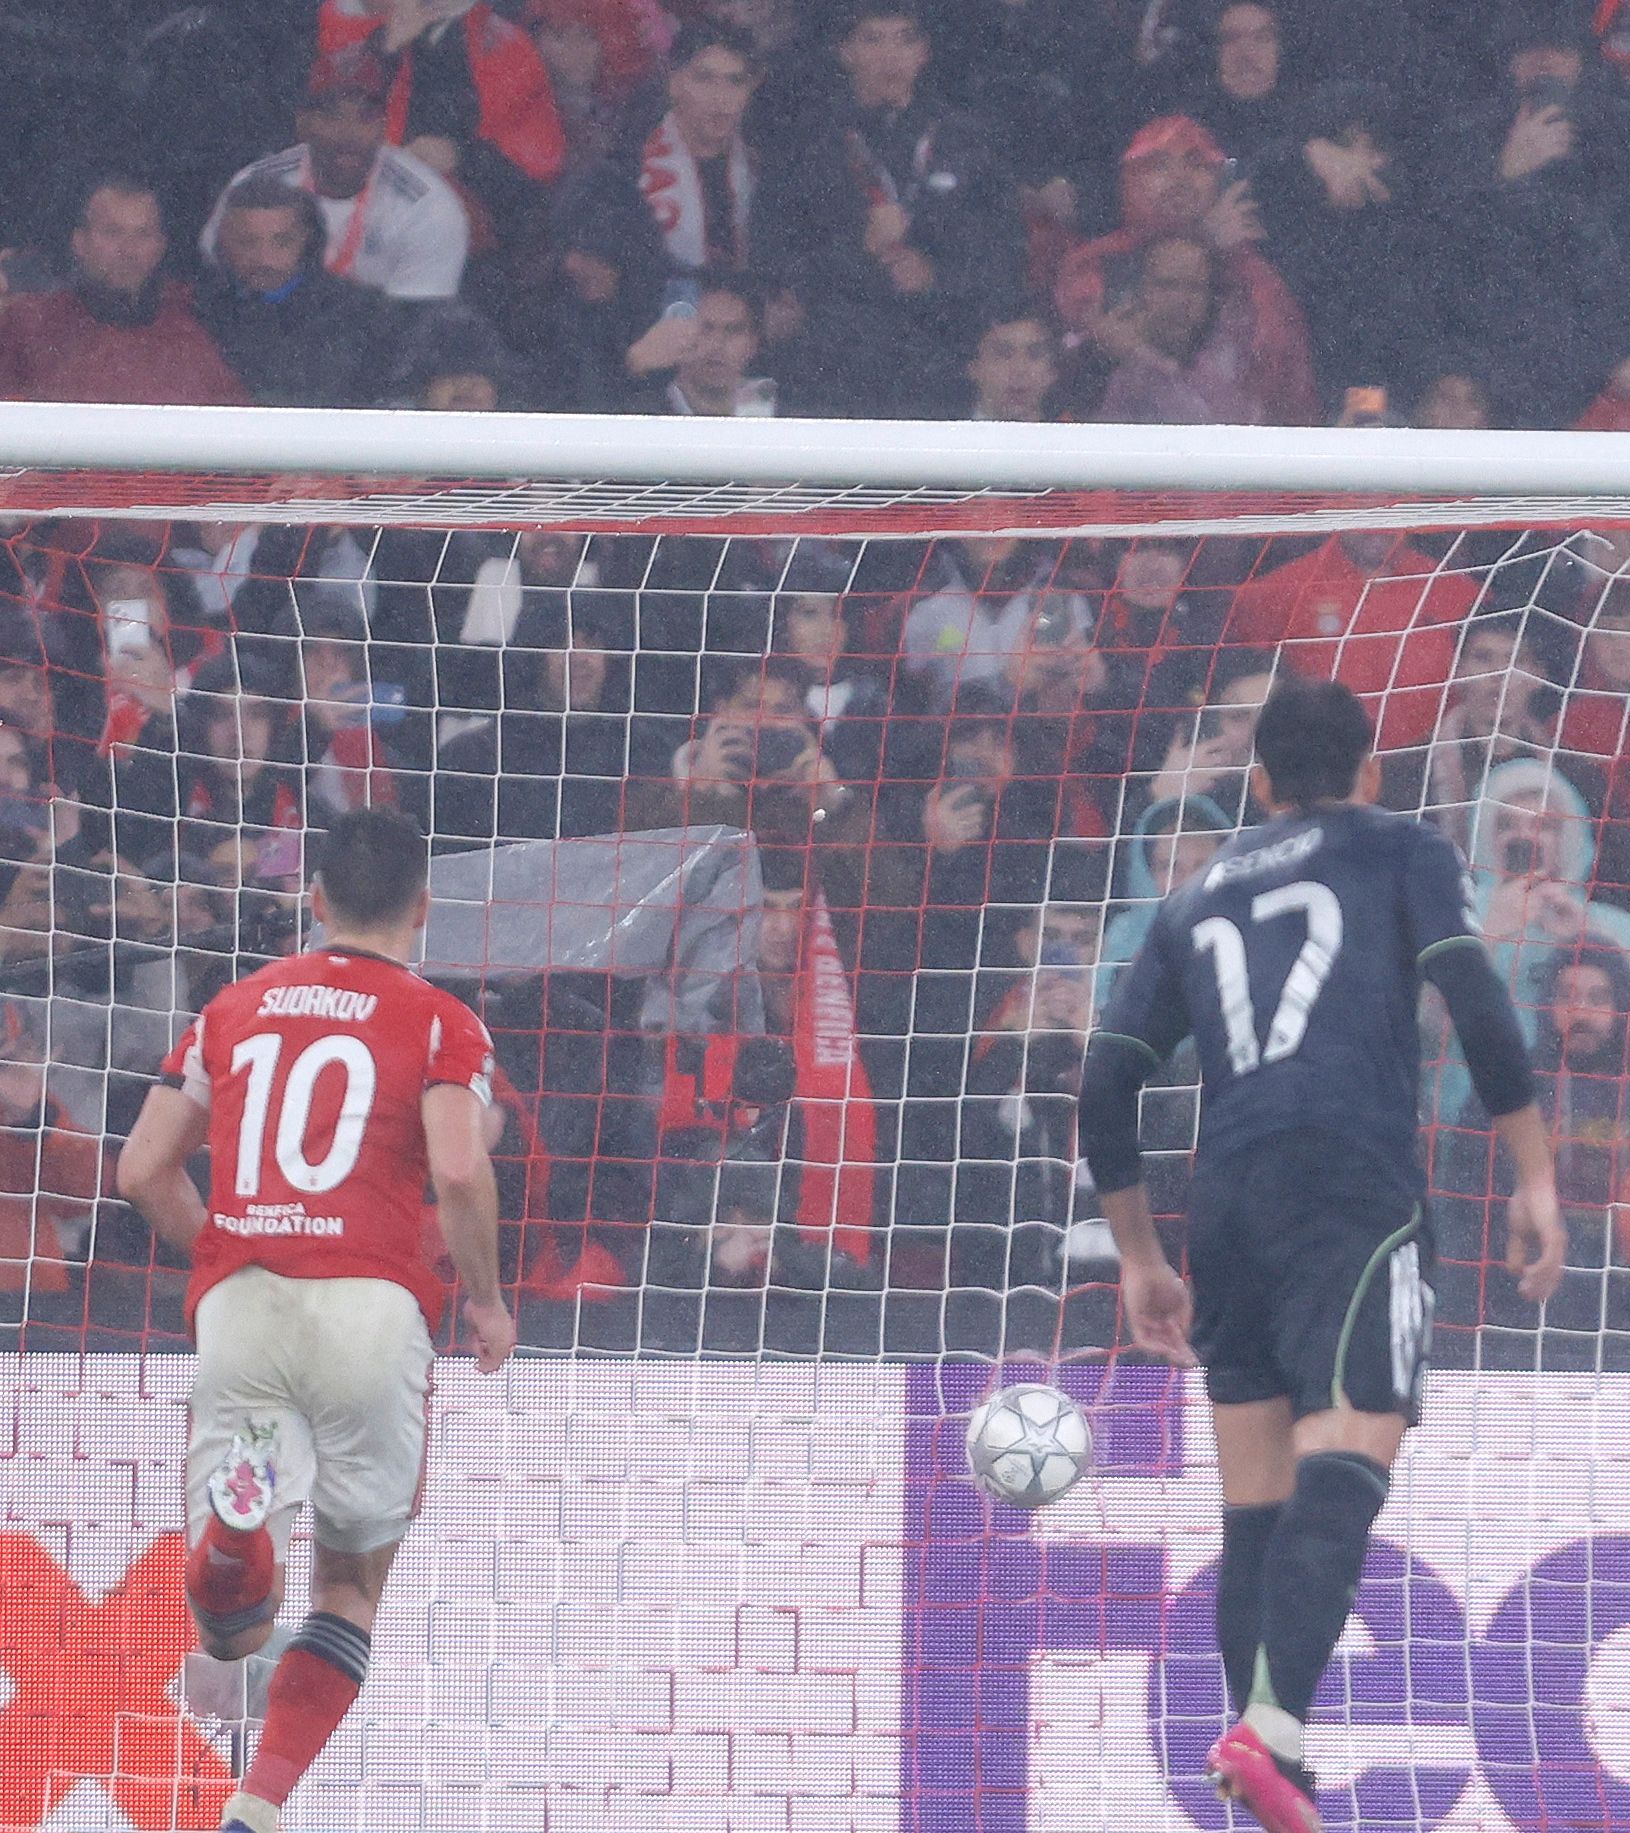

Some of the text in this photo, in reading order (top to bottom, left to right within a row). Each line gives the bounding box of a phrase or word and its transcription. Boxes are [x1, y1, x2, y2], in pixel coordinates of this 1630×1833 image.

[1191, 880, 1344, 1077] 17
[256, 985, 379, 1021] SUDAKOV
[230, 1032, 376, 1197] 10
[213, 1213, 344, 1236] FOUNDATION
[245, 1202, 305, 1216] BENFICA
